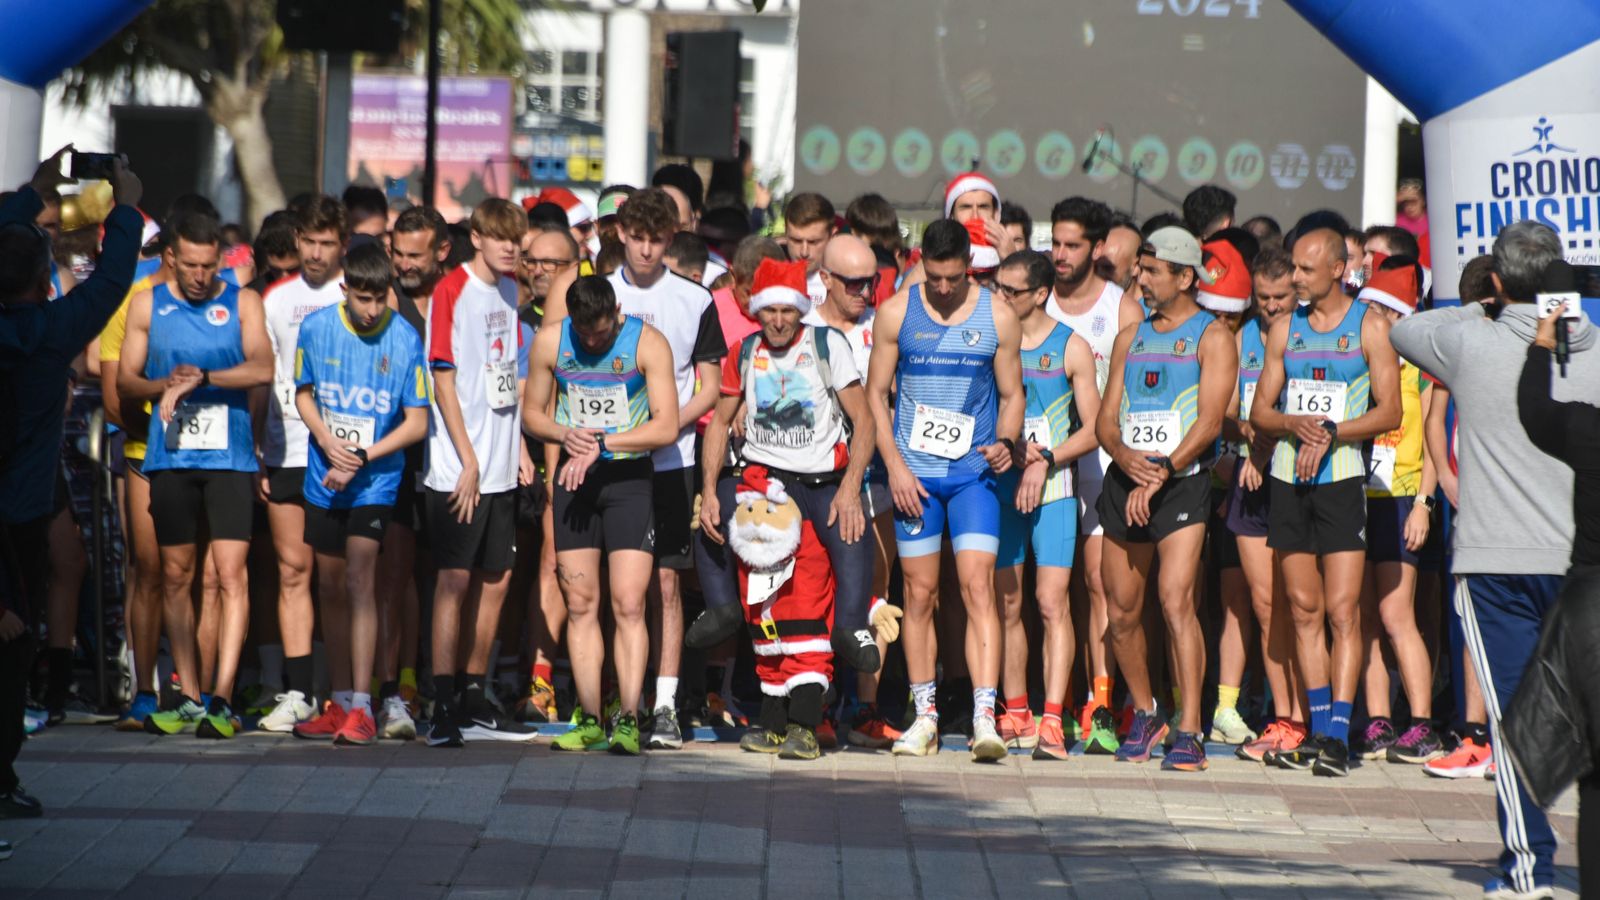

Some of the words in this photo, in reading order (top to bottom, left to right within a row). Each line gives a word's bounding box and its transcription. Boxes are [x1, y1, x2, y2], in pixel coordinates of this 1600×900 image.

[1231, 153, 1257, 174] 10
[1491, 157, 1600, 199] CRONO
[1455, 196, 1600, 239] FINISH
[319, 381, 391, 415] EVOS
[579, 398, 616, 416] 192
[1297, 393, 1332, 413] 163
[177, 416, 215, 435] 187
[922, 421, 961, 444] 229
[1132, 425, 1168, 444] 236
[1028, 431, 1039, 444] 4
[1370, 458, 1382, 476] 7
[768, 575, 774, 590] 1
